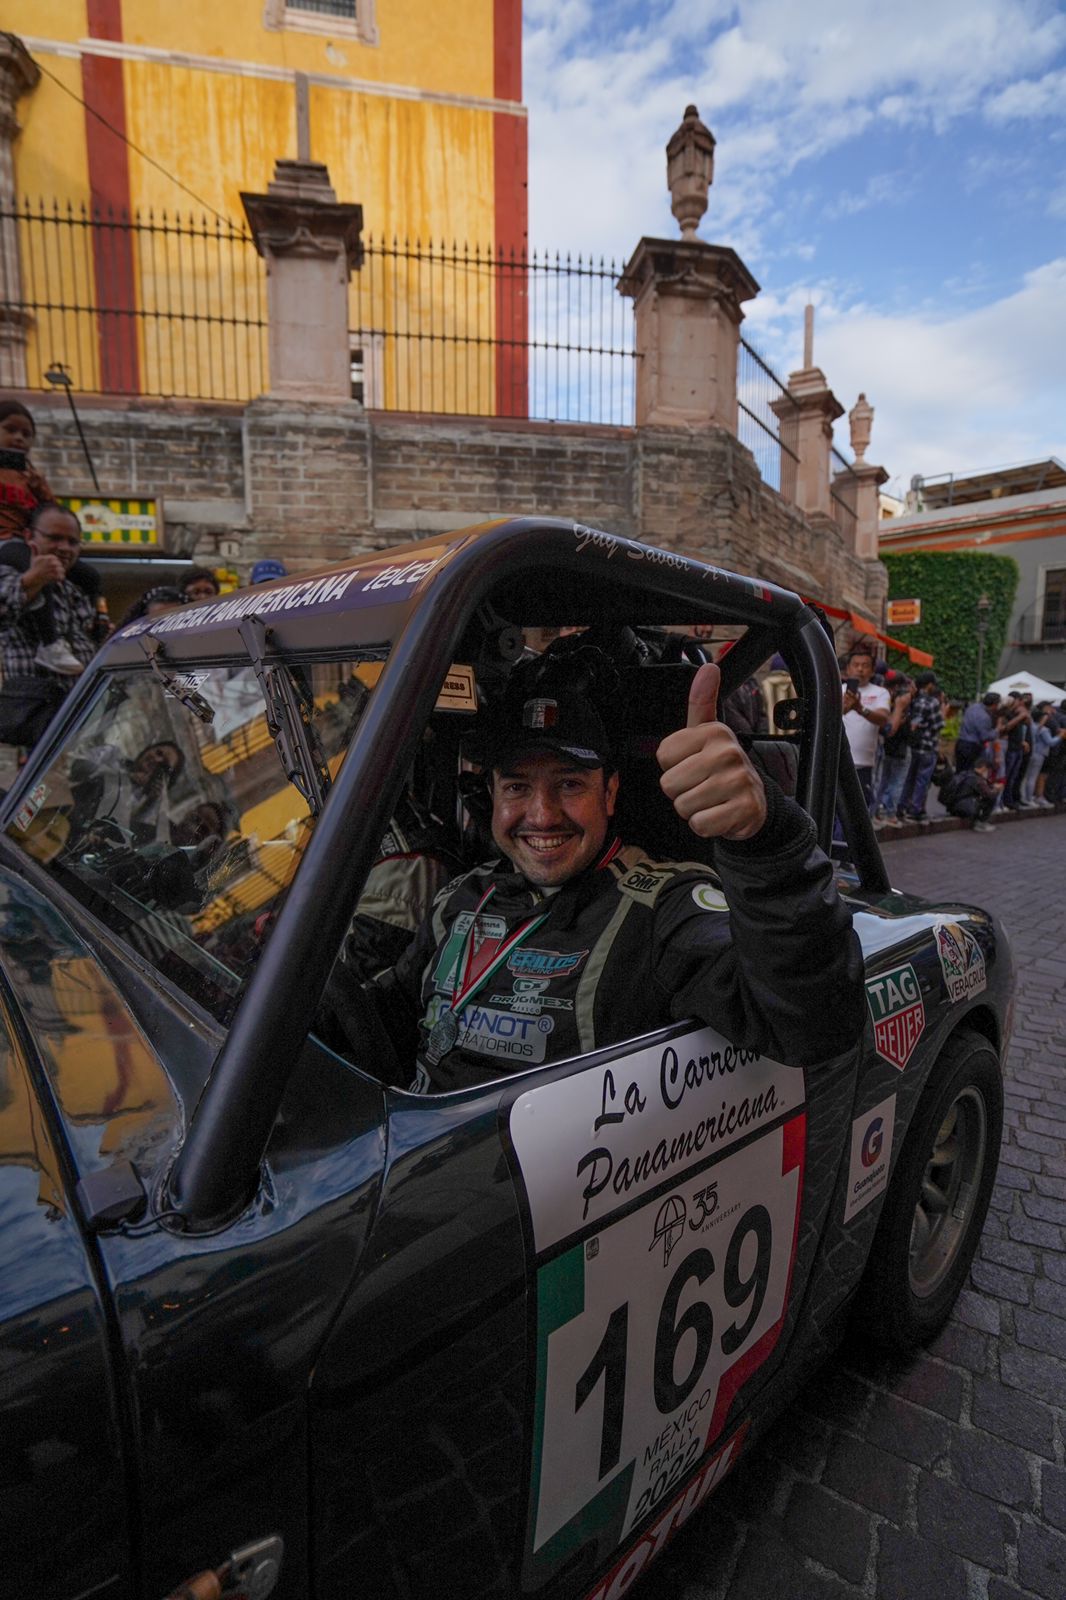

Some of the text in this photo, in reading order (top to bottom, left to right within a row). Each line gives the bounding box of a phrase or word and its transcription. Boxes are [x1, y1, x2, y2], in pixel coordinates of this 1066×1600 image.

[572, 523, 619, 560] Guy
[626, 540, 690, 572] Savoir
[149, 603, 219, 634] CARRERA
[209, 570, 360, 623] PANAMERICANA
[627, 873, 660, 890] OMP
[511, 950, 580, 969] GRILLOS
[947, 966, 986, 998] VERACRUZ
[490, 994, 573, 1008] DRUGMEX
[868, 969, 918, 1015] TAG
[876, 1006, 924, 1065] HEUER
[594, 1069, 647, 1132] La
[576, 1084, 779, 1220] Panamericana
[688, 1181, 719, 1231] 35
[700, 1203, 742, 1233] ANNIVERSARY
[575, 1204, 773, 1482] 169
[648, 1420, 698, 1481] RALLY
[630, 1437, 700, 1529] 2022
